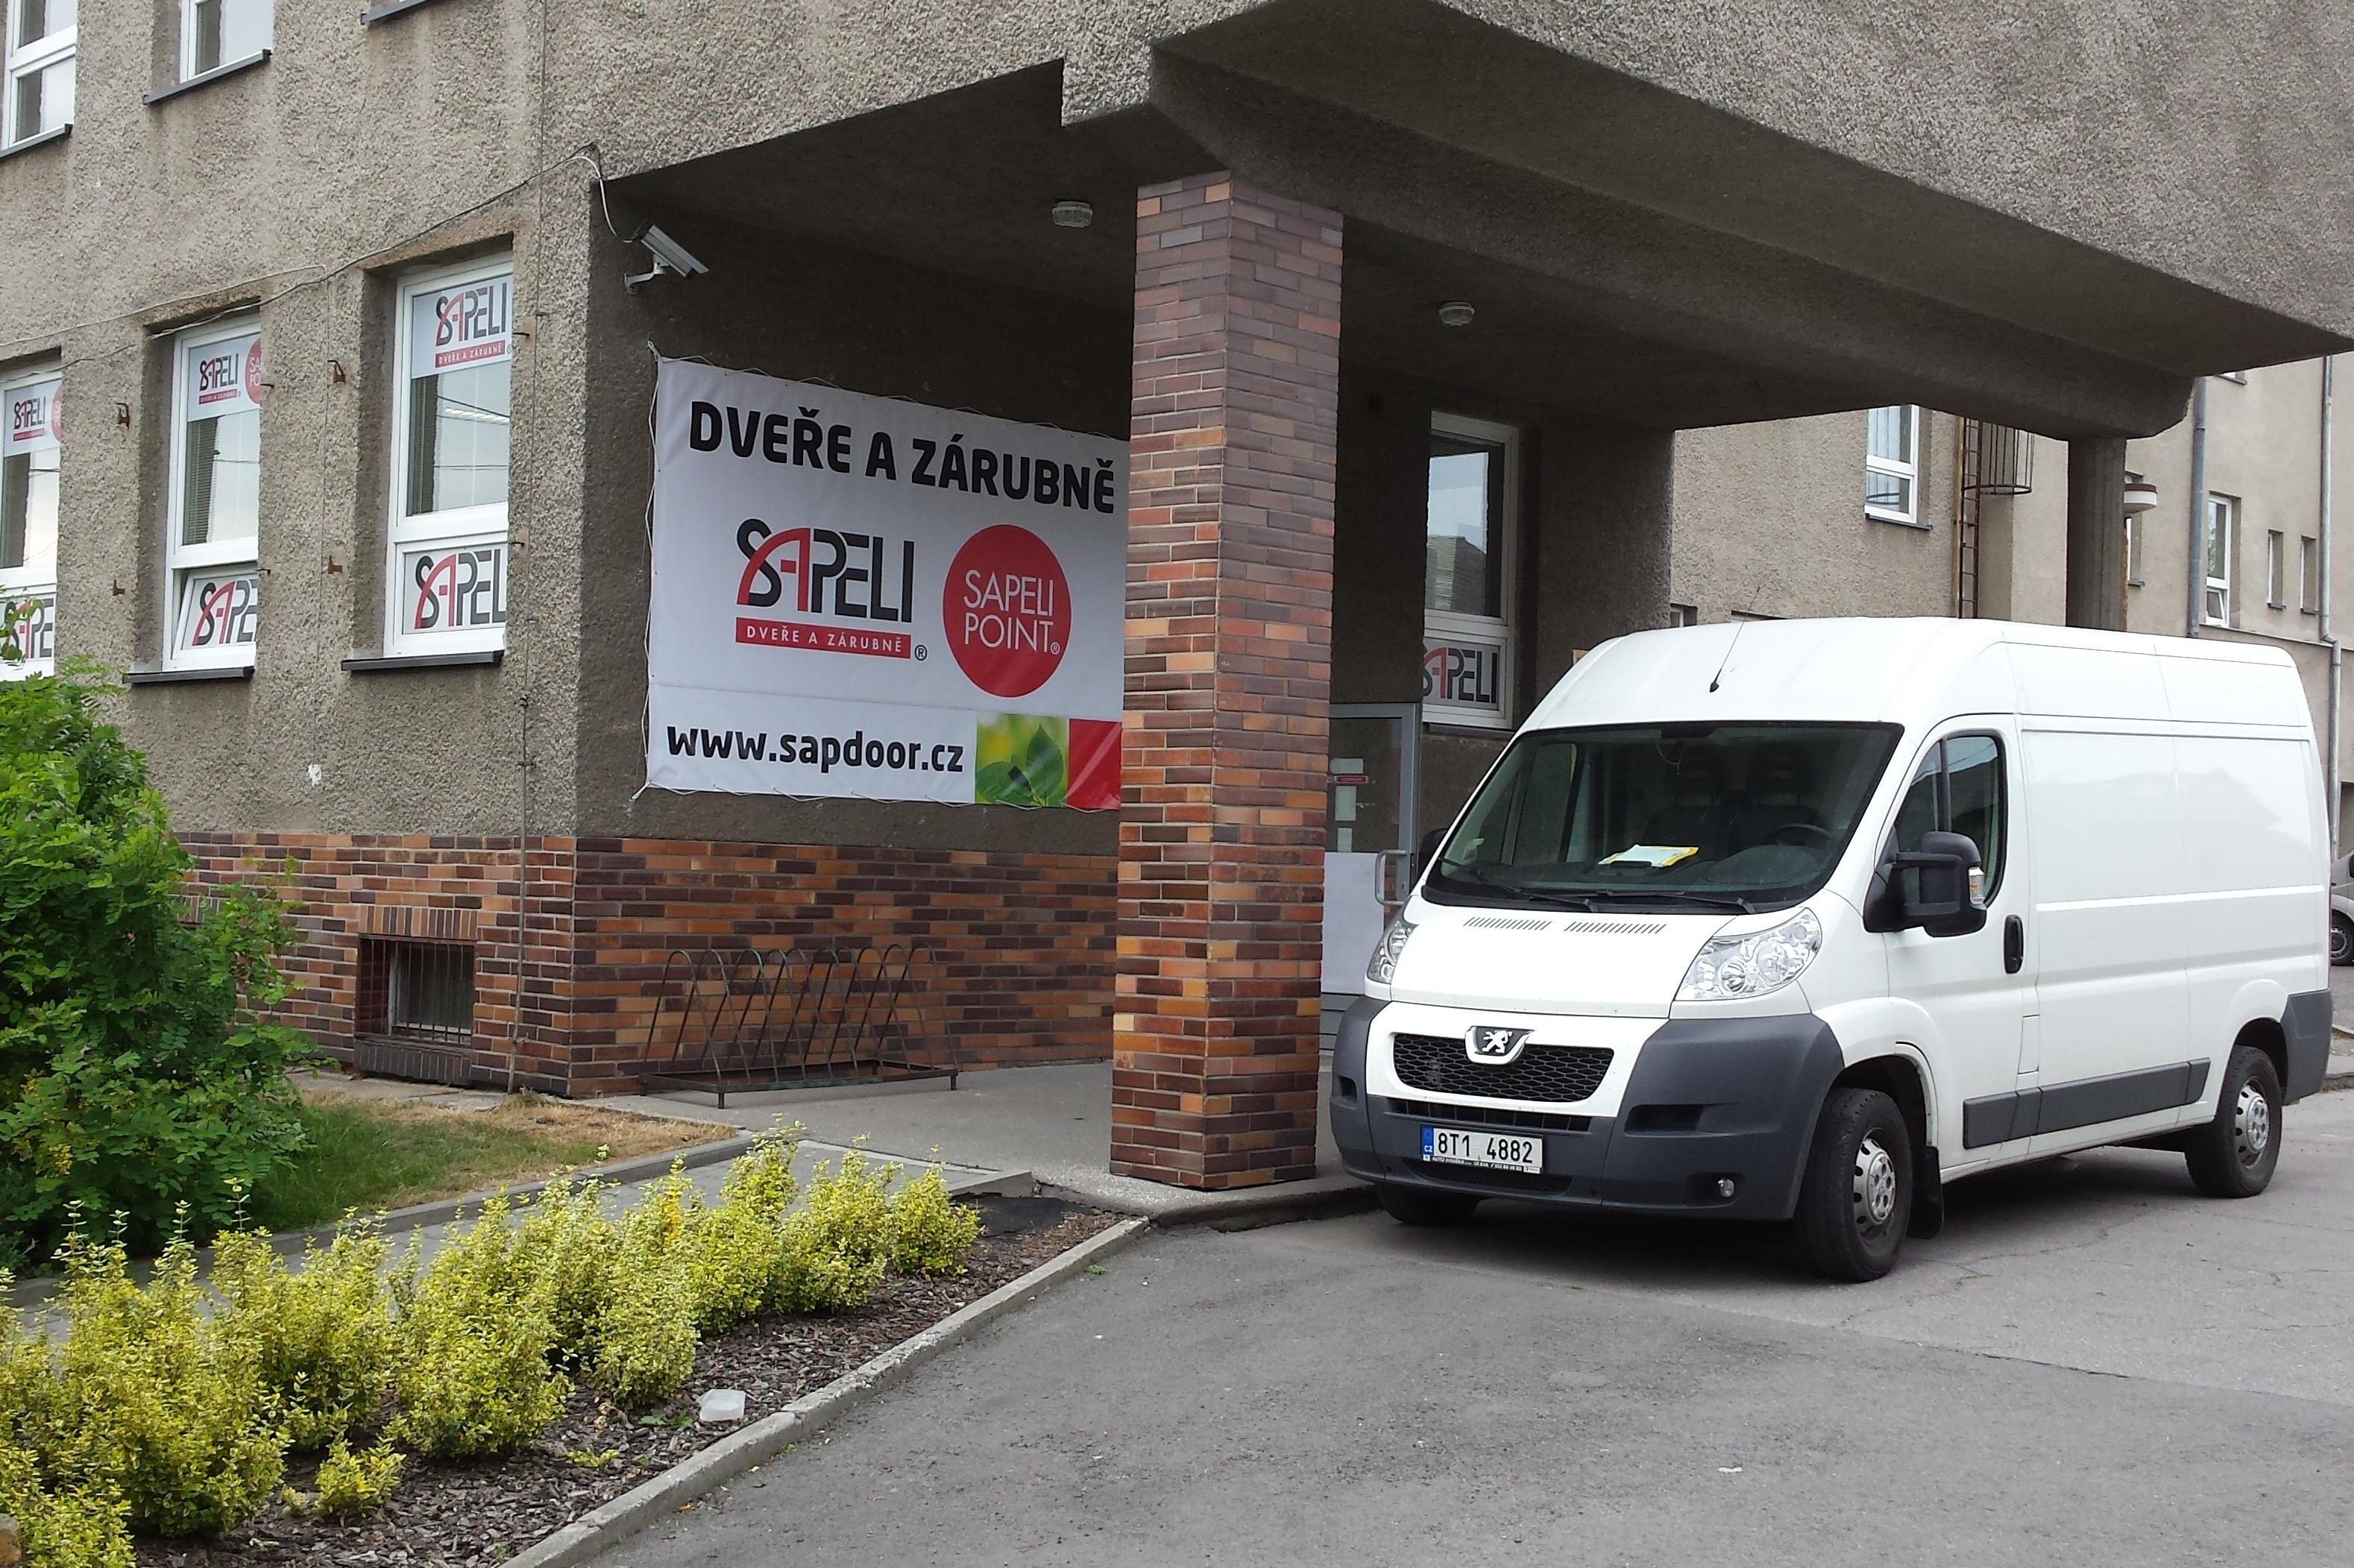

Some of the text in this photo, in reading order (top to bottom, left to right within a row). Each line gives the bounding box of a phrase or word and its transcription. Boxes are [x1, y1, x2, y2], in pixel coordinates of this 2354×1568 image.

[435, 282, 507, 347] SAPELI
[199, 353, 239, 391] SAPELI
[13, 396, 46, 430] SAPELI
[690, 400, 1115, 514] DVEŘE A ZÁRUBNĚ
[415, 549, 507, 629] SAPEL
[736, 518, 915, 623] SAPELI
[963, 569, 1054, 617] SAPELI
[192, 579, 258, 646] SAPE
[964, 611, 1054, 653] POINT
[746, 625, 901, 653] DVEŘE A ZÁRUBNĚ
[667, 725, 964, 773] www.sapdoor.cz
[1424, 1144, 1433, 1153] CZ
[1438, 1132, 1533, 1164] 8T1 4882
